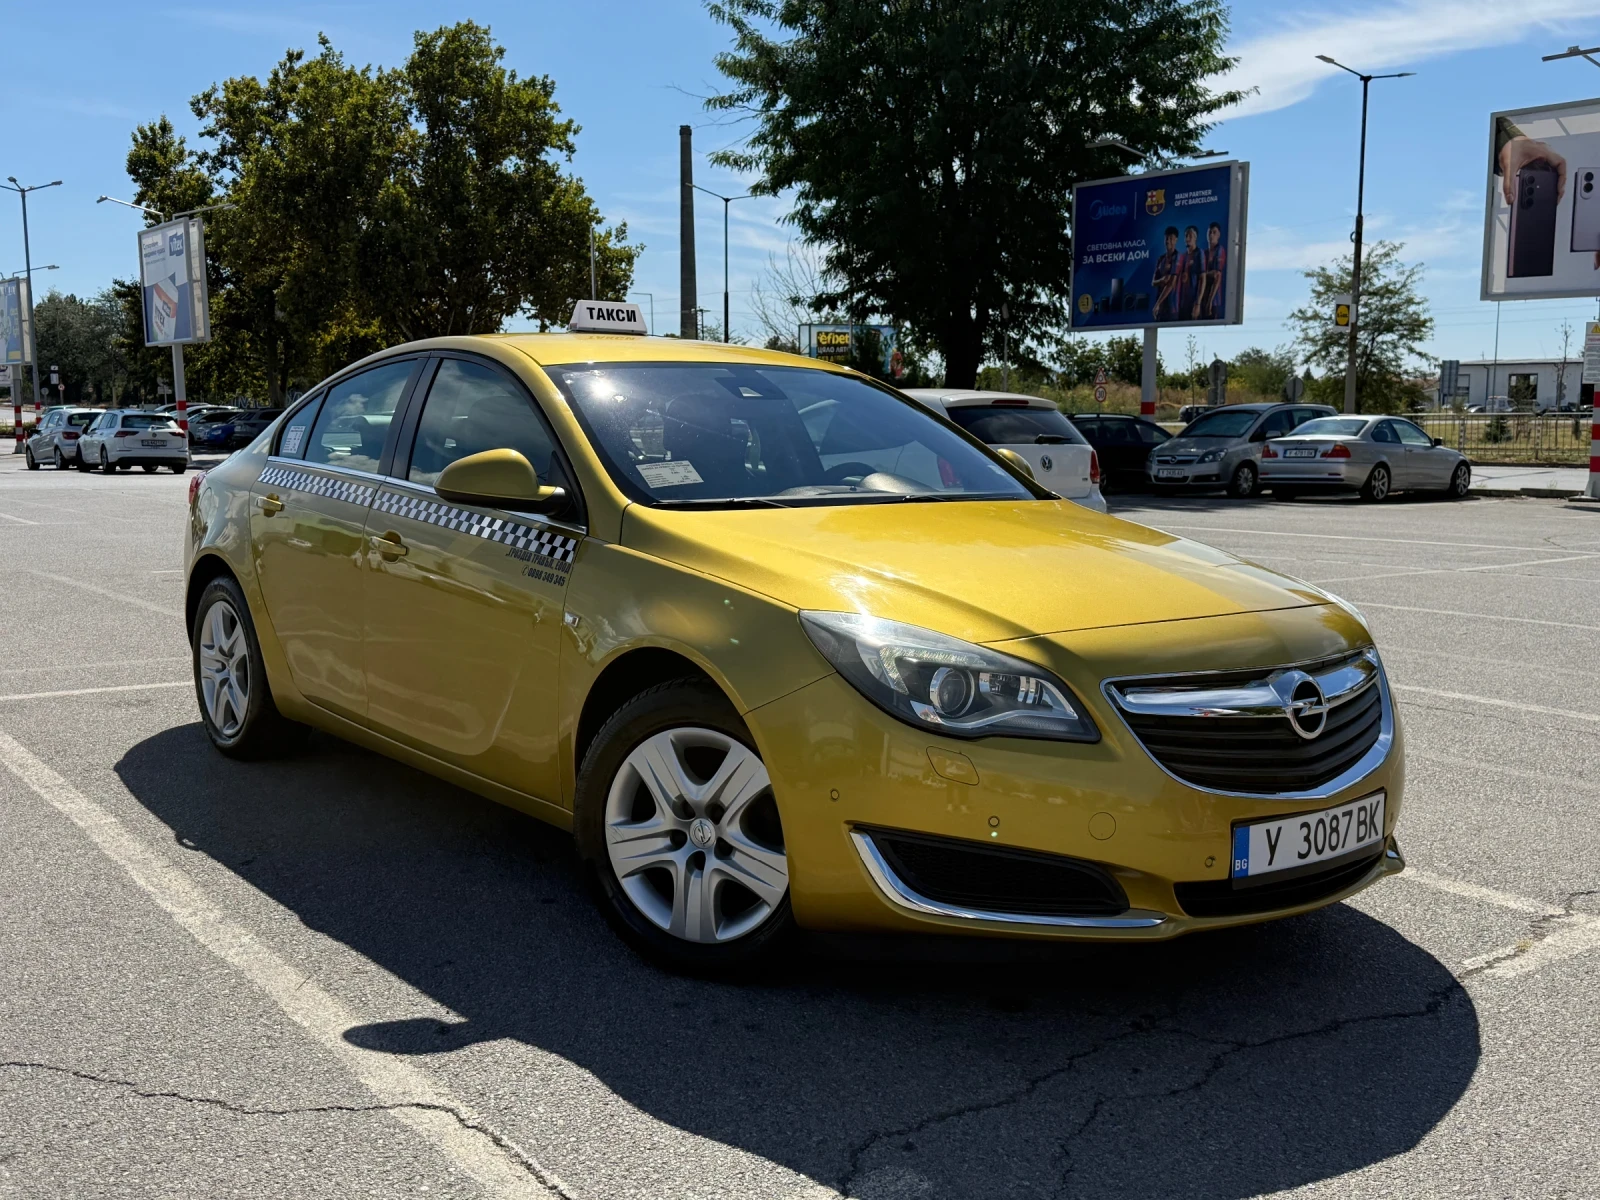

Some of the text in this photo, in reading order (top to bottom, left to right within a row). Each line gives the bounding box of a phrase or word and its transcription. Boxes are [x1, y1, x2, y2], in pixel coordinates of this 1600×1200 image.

[1175, 189, 1212, 200] MAIN PARTNER
[1188, 195, 1218, 205] BARCELONA
[1087, 239, 1146, 252] СВЕТОВНА КЛАСА
[1082, 249, 1149, 264] ЗА ВСЕКИ ДОМ
[586, 306, 637, 323] ТАКСИ
[818, 332, 849, 344] efbet
[542, 571, 555, 584] 349
[553, 574, 566, 587] 345
[1234, 858, 1248, 871] BG
